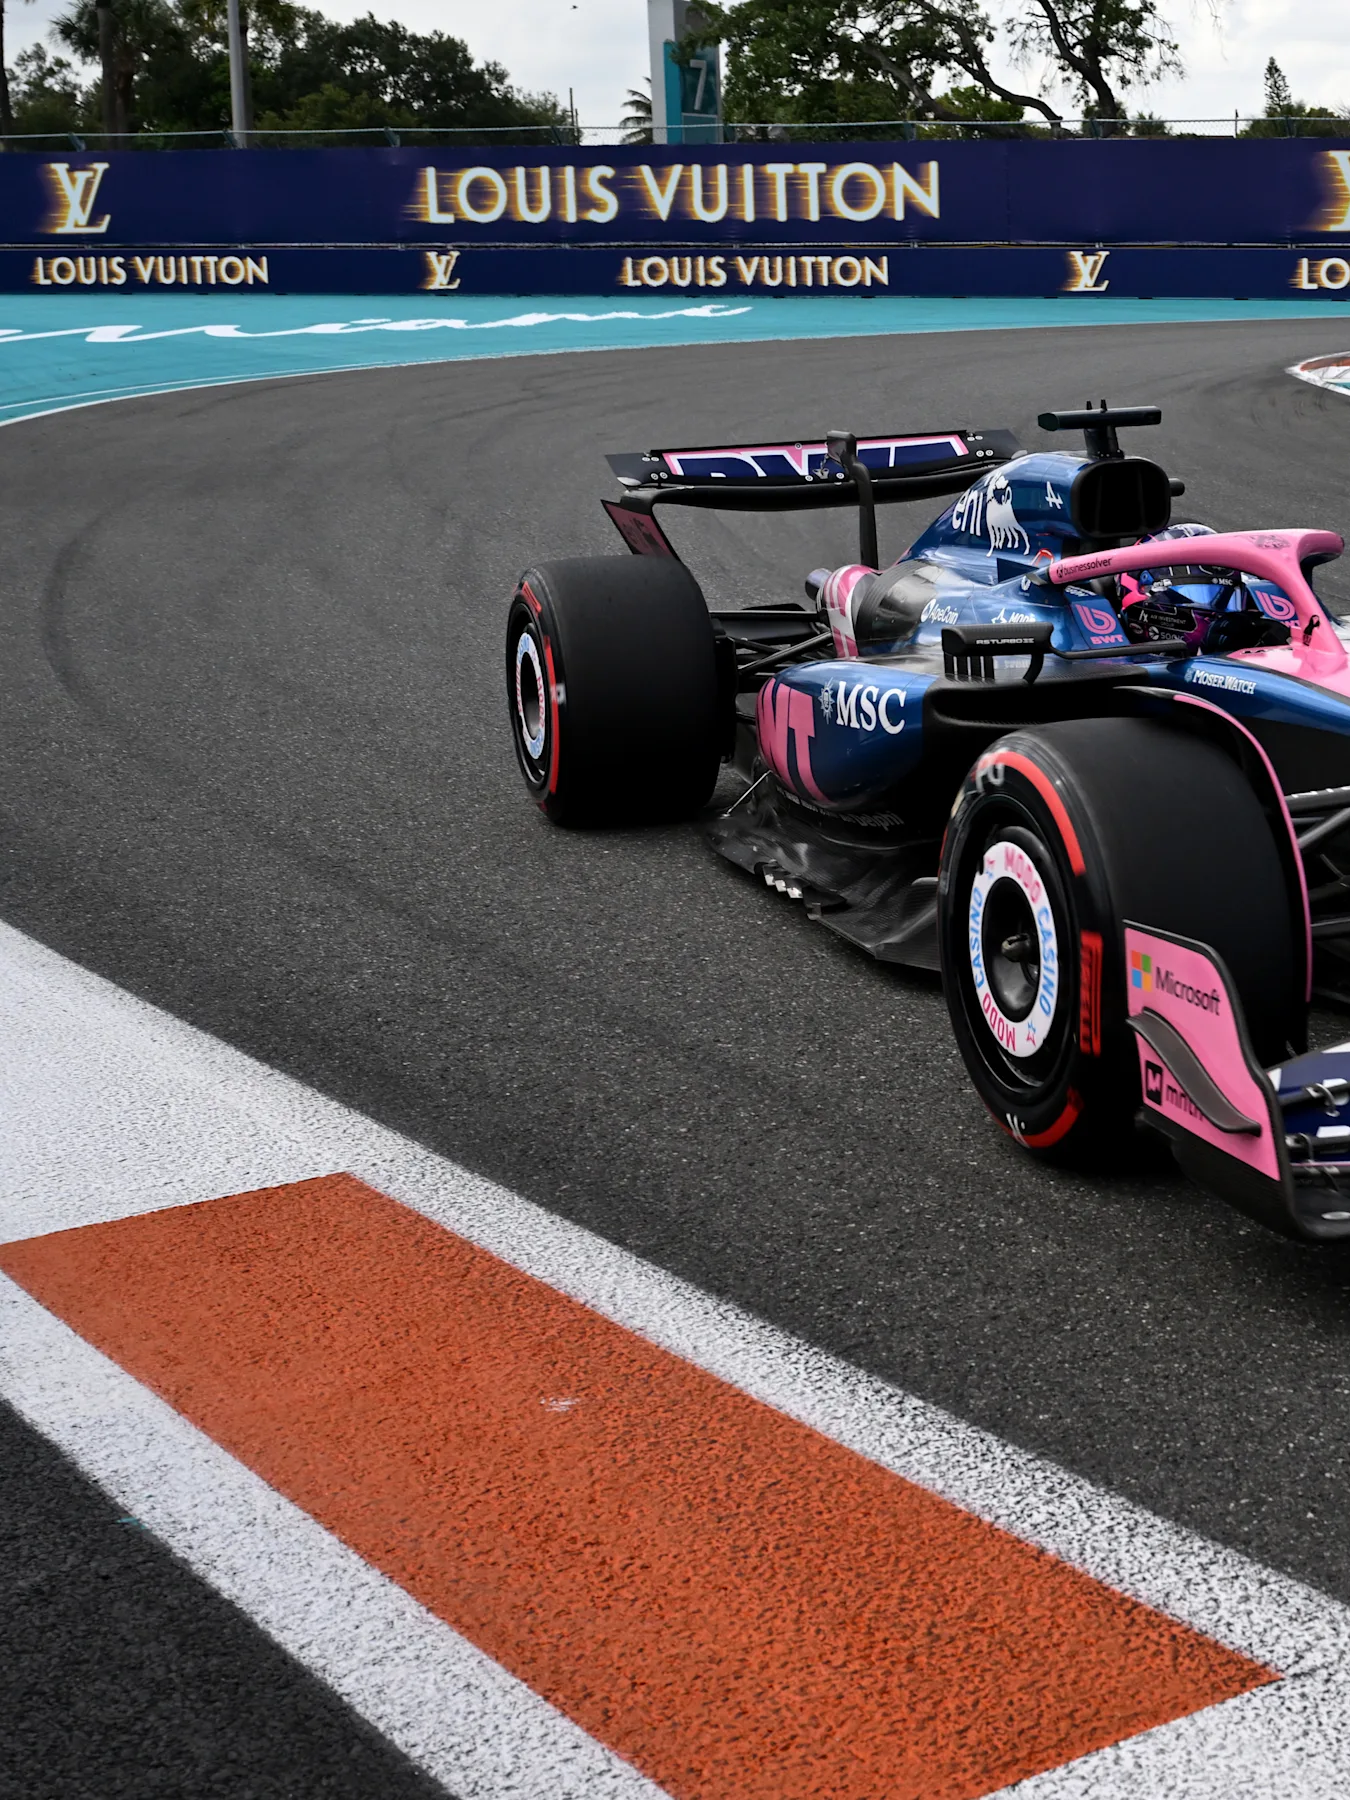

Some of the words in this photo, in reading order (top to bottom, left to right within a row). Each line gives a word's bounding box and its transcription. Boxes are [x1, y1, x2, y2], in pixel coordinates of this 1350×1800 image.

[426, 165, 619, 224] LOUIS
[640, 160, 940, 223] VUITTON
[36, 256, 127, 285] LOUIS
[135, 256, 269, 285] VUITTON
[625, 256, 728, 287] LOUIS
[736, 256, 889, 287] VUITTON
[952, 488, 983, 536] eni
[1063, 556, 1113, 578] businessolver
[1090, 634, 1124, 645] BWT
[836, 680, 907, 735] MSC
[971, 886, 984, 990] CASINO
[1037, 905, 1057, 1017] CASINO
[1155, 966, 1221, 1016] Microsoft
[982, 991, 1017, 1051] MODO
